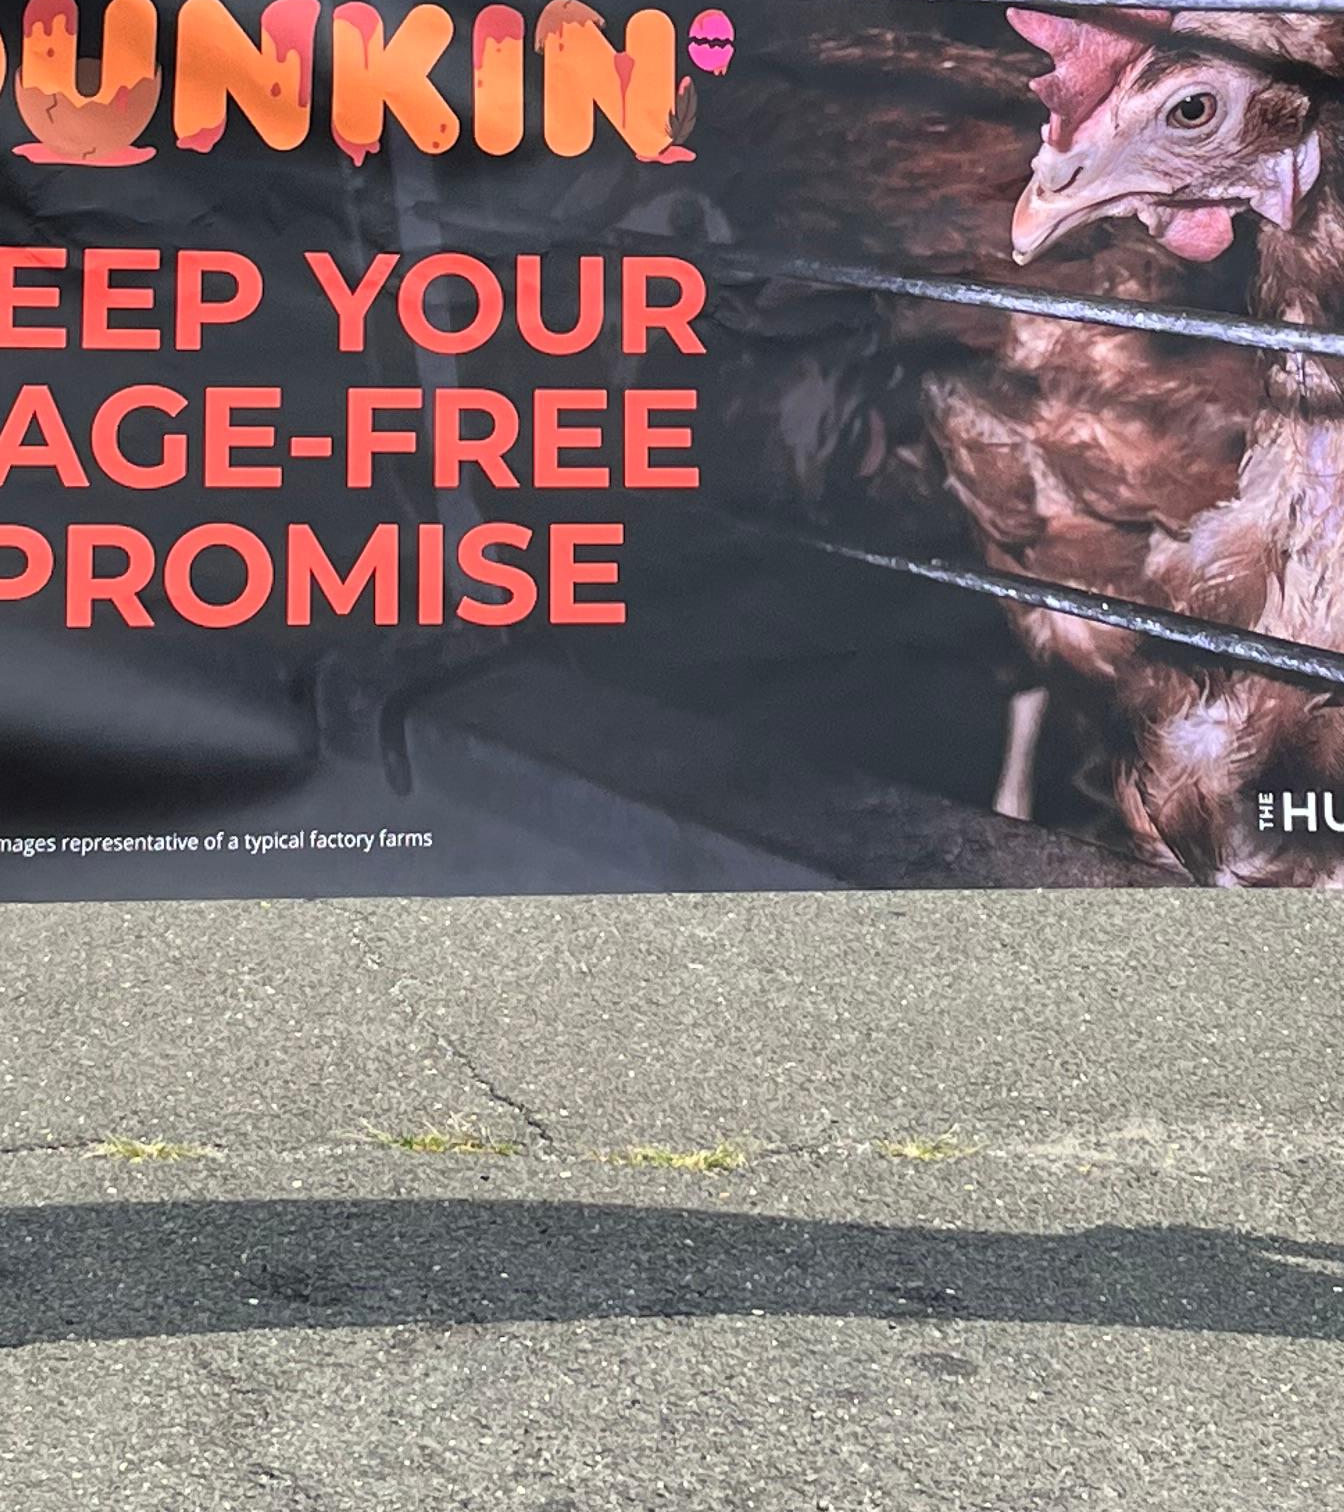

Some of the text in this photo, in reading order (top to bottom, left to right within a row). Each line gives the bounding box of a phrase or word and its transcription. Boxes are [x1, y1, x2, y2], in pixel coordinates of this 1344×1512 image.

[304, 251, 708, 355] YOUR
[1257, 791, 1275, 831] THE
[60, 832, 198, 857] representative
[203, 831, 225, 851] of
[227, 836, 239, 851] a
[244, 829, 305, 855] typical
[309, 829, 375, 853] factory
[378, 828, 433, 848] farms
